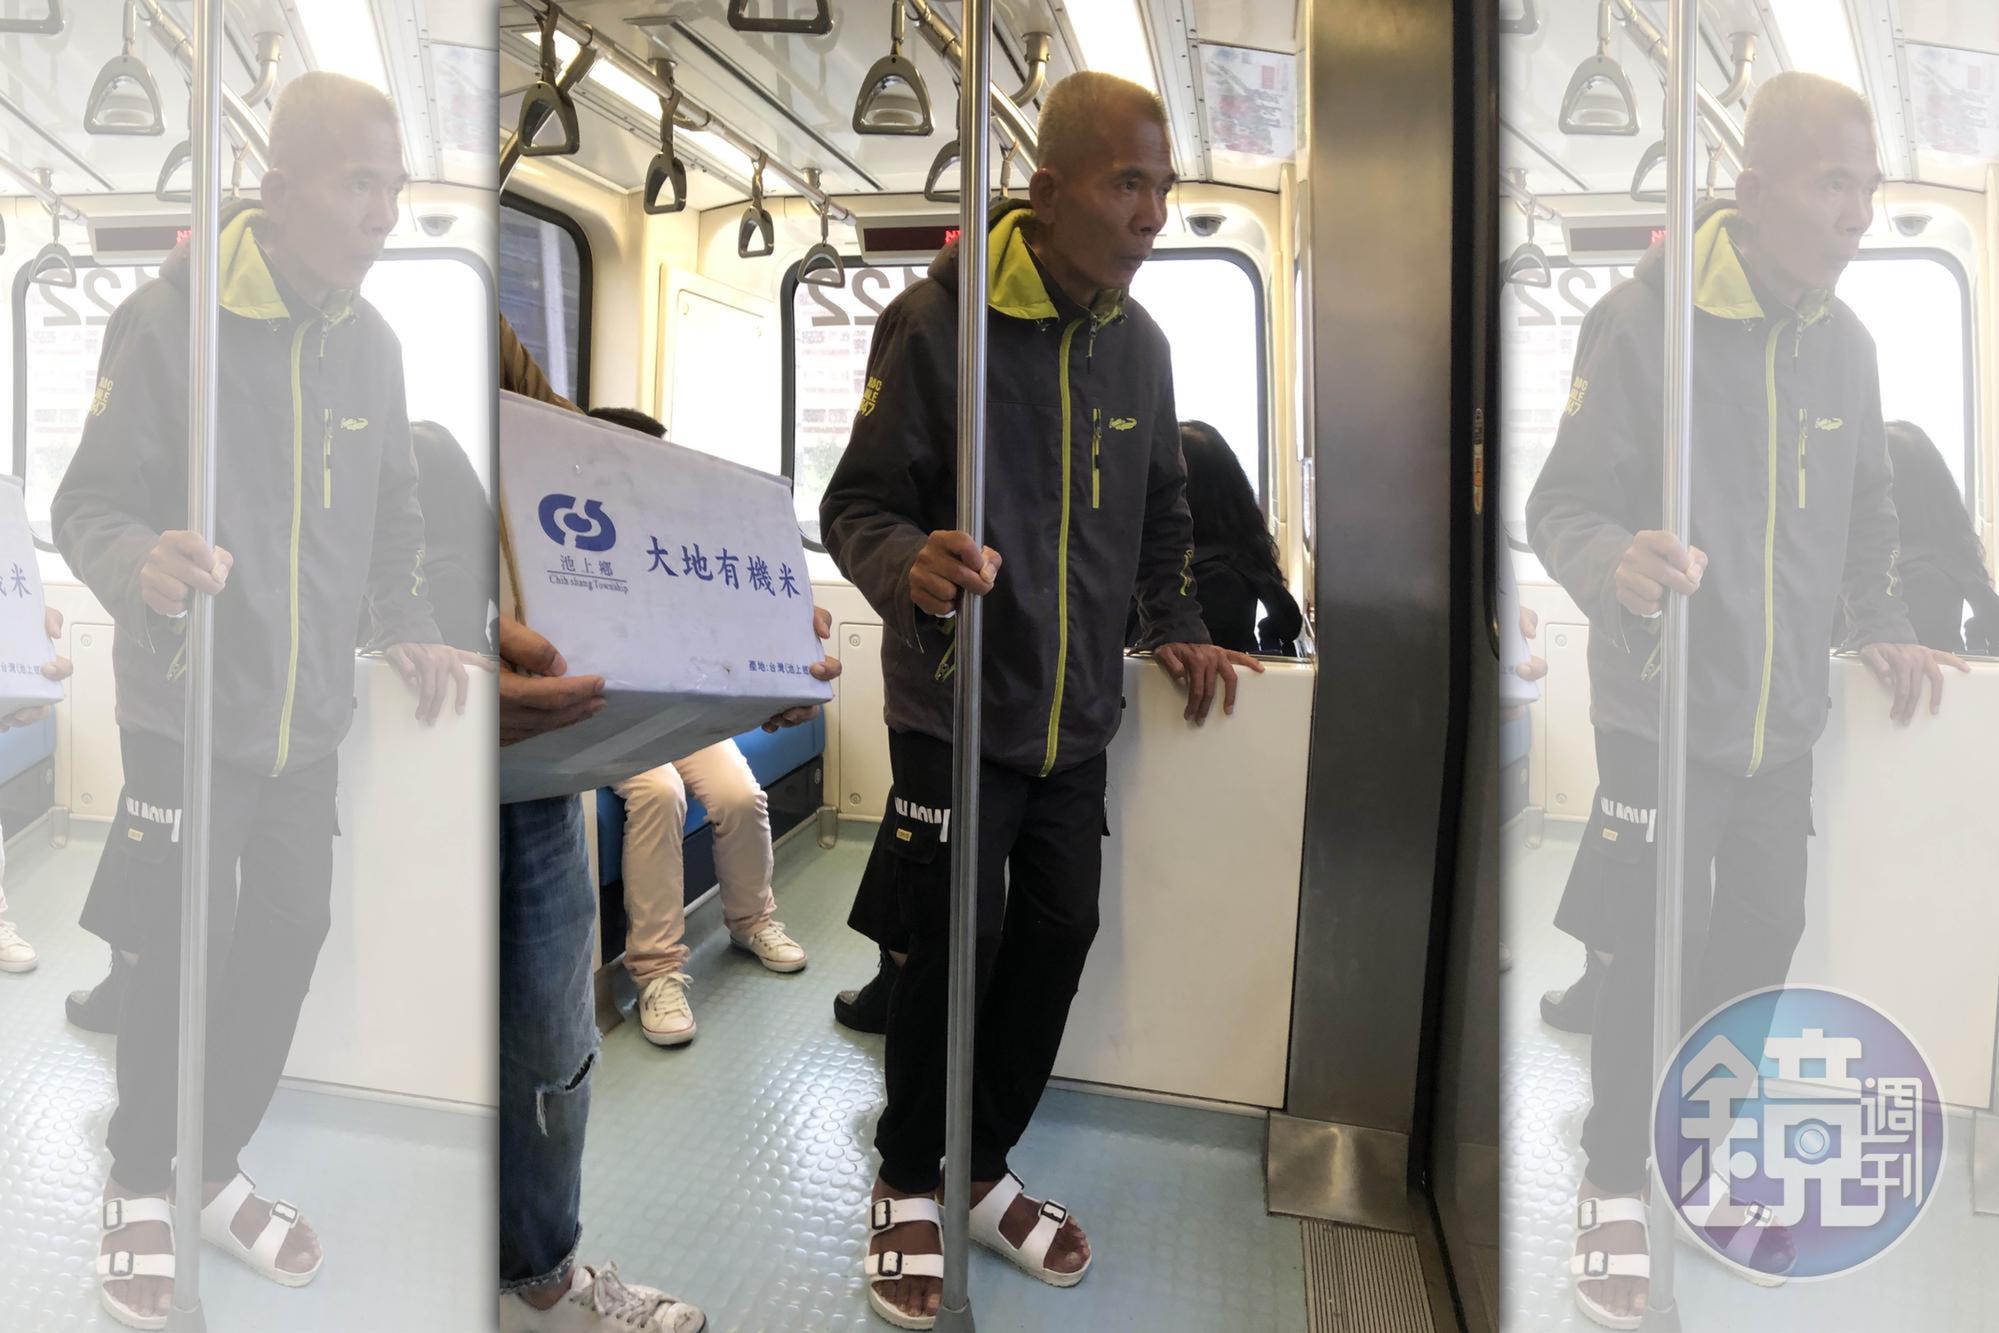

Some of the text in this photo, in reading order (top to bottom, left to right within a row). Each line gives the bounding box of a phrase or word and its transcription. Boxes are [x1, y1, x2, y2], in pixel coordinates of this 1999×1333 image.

[559, 553, 614, 577] 池上鄉
[646, 535, 801, 599] 大地有機米
